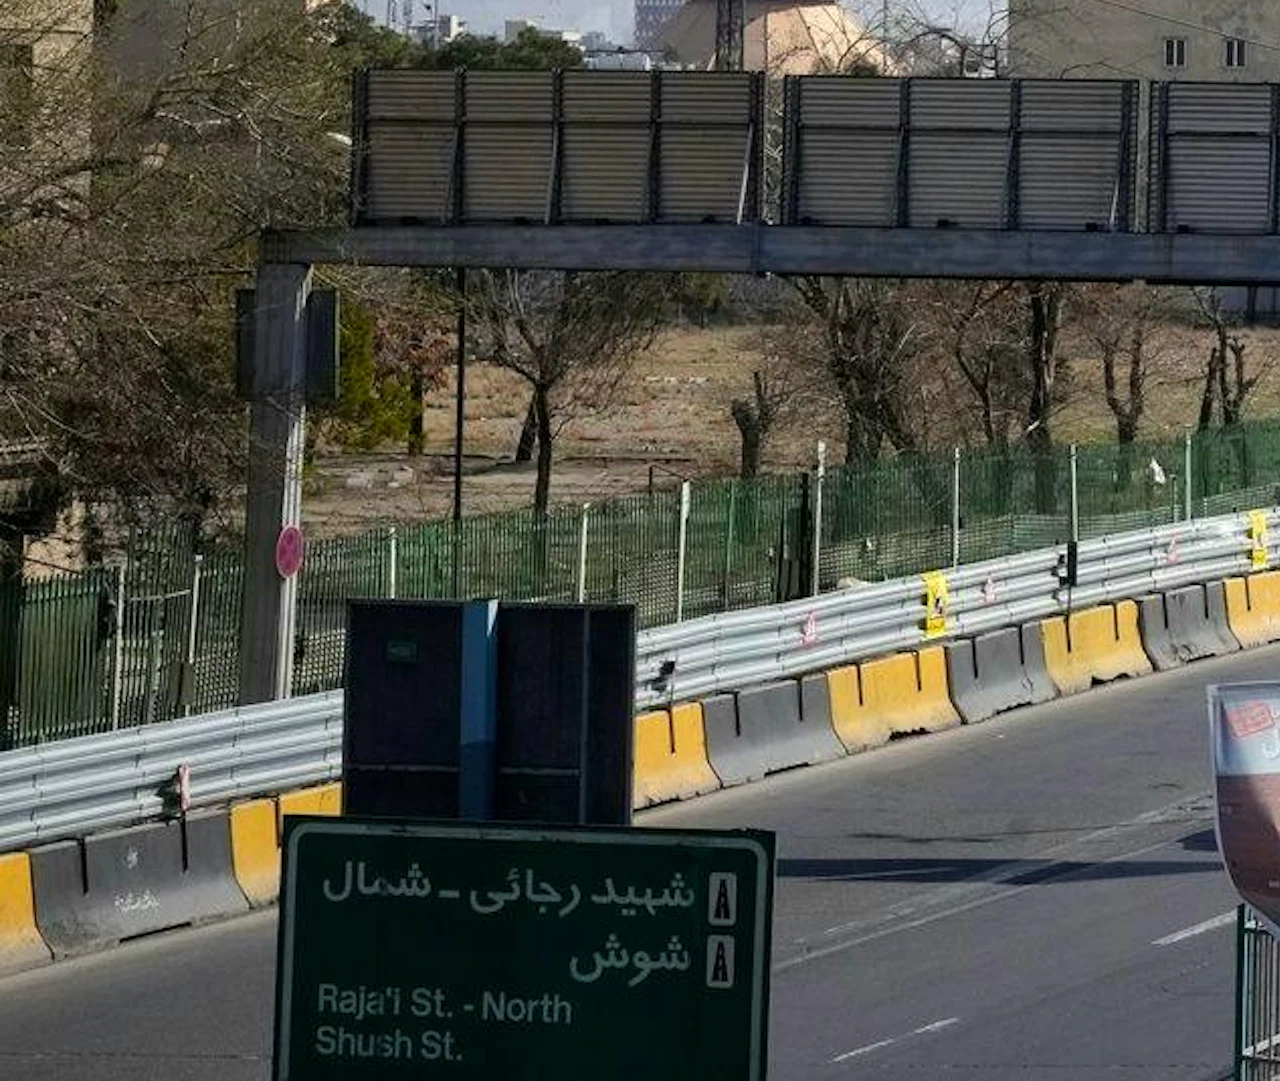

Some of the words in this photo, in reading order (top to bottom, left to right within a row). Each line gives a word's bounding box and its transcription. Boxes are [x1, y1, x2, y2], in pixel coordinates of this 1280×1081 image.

[322, 859, 431, 903] شمال
[469, 867, 581, 917] رجائی
[592, 872, 696, 917] شهید
[568, 932, 692, 987] شوش
[317, 982, 400, 1020] Raja'i
[410, 986, 454, 1019] St.
[481, 990, 572, 1024] North
[315, 1024, 414, 1060] Shush
[420, 1029, 464, 1062] St.
